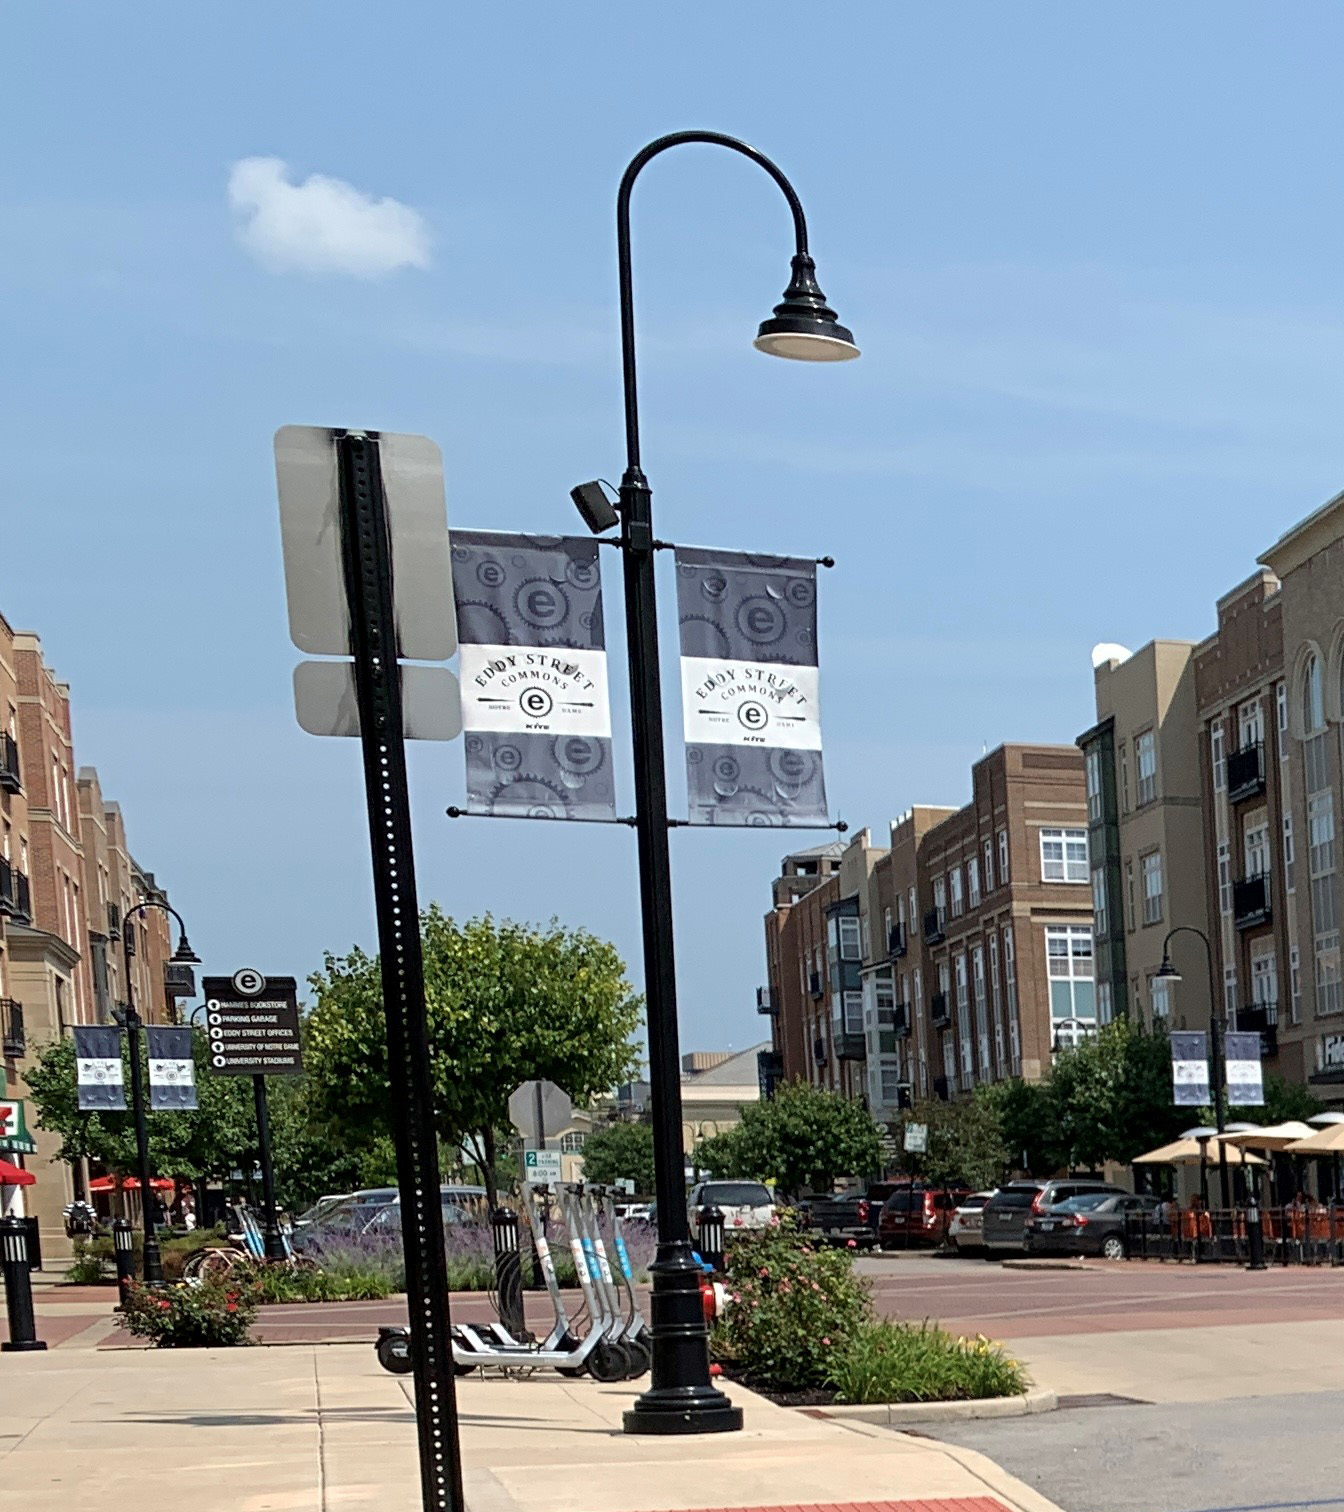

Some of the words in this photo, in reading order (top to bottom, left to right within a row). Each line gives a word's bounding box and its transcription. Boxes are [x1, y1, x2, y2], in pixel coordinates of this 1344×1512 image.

[474, 654, 517, 688] EDDY
[526, 653, 595, 691] STREET
[501, 670, 569, 691] COMMONS
[695, 669, 736, 700] EDDY
[744, 668, 808, 706] STREET
[720, 684, 784, 704] COMMONS
[240, 974, 257, 989] e
[222, 1015, 250, 1023] PARKING
[251, 1015, 278, 1023] GARAGE
[225, 1043, 256, 1051] UNIVERSITY
[226, 1057, 262, 1065] UNIVERSITY
[528, 1153, 536, 1165] 2
